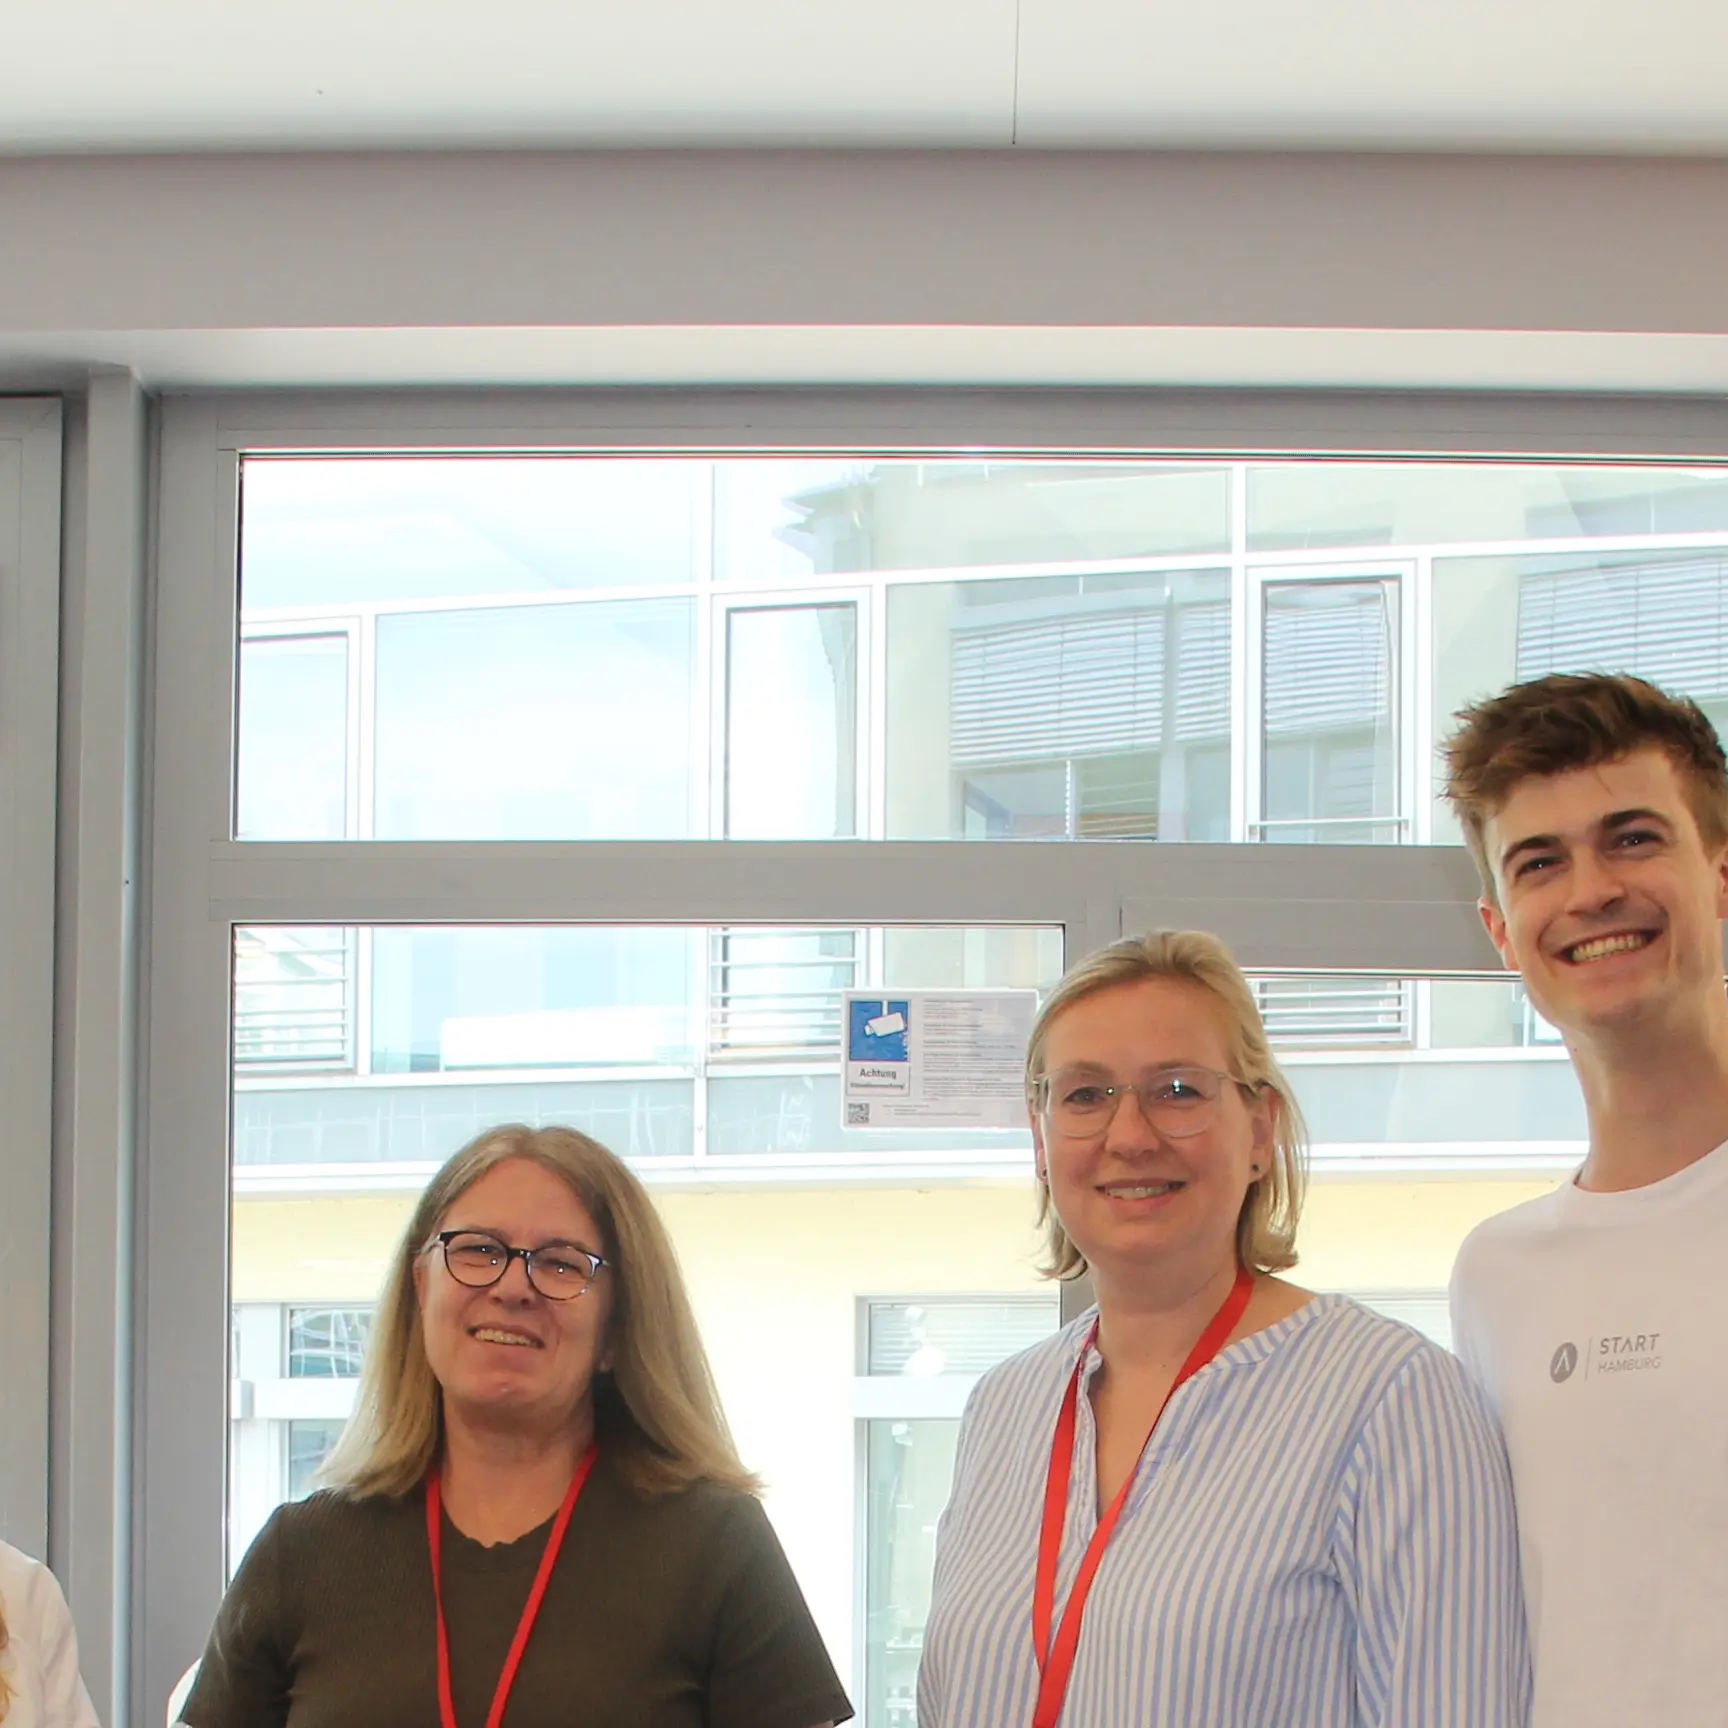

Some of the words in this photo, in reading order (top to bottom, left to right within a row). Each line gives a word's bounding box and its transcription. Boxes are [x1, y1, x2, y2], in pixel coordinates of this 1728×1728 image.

[859, 1068, 897, 1080] Achtung
[1599, 1333, 1660, 1355] START
[1598, 1357, 1662, 1373] HAMBURG
